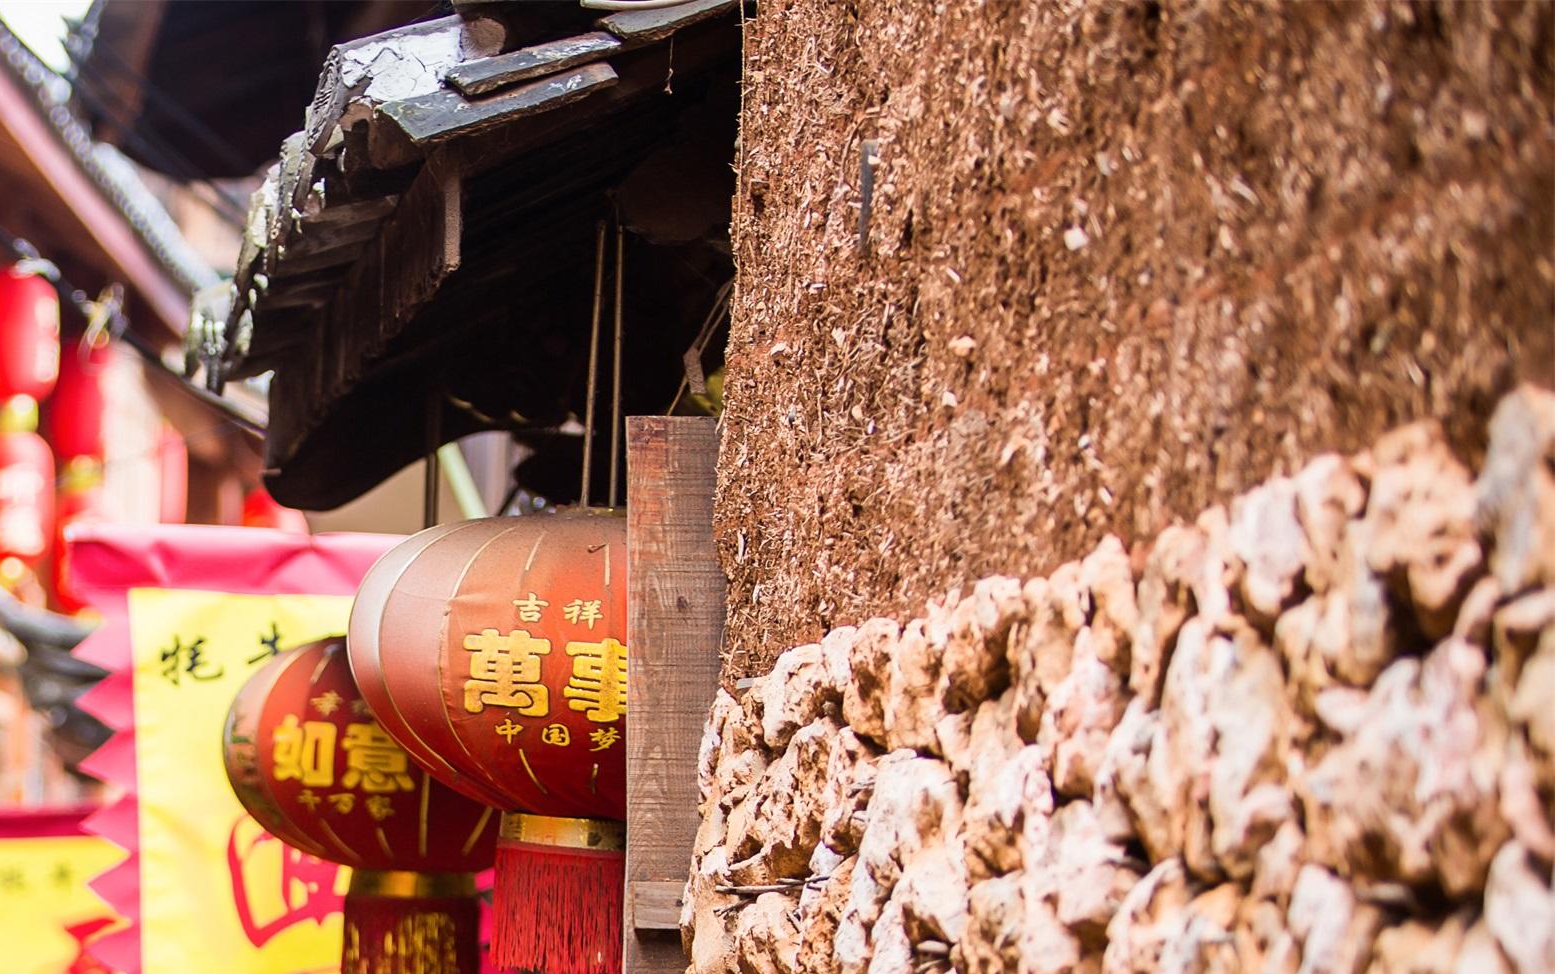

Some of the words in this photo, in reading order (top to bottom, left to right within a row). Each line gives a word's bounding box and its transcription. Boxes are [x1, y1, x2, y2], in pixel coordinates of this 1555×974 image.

[512, 592, 605, 630] 吉祥
[461, 628, 628, 723] 萬事
[272, 713, 416, 794] 如意
[494, 718, 623, 752] 中国梦
